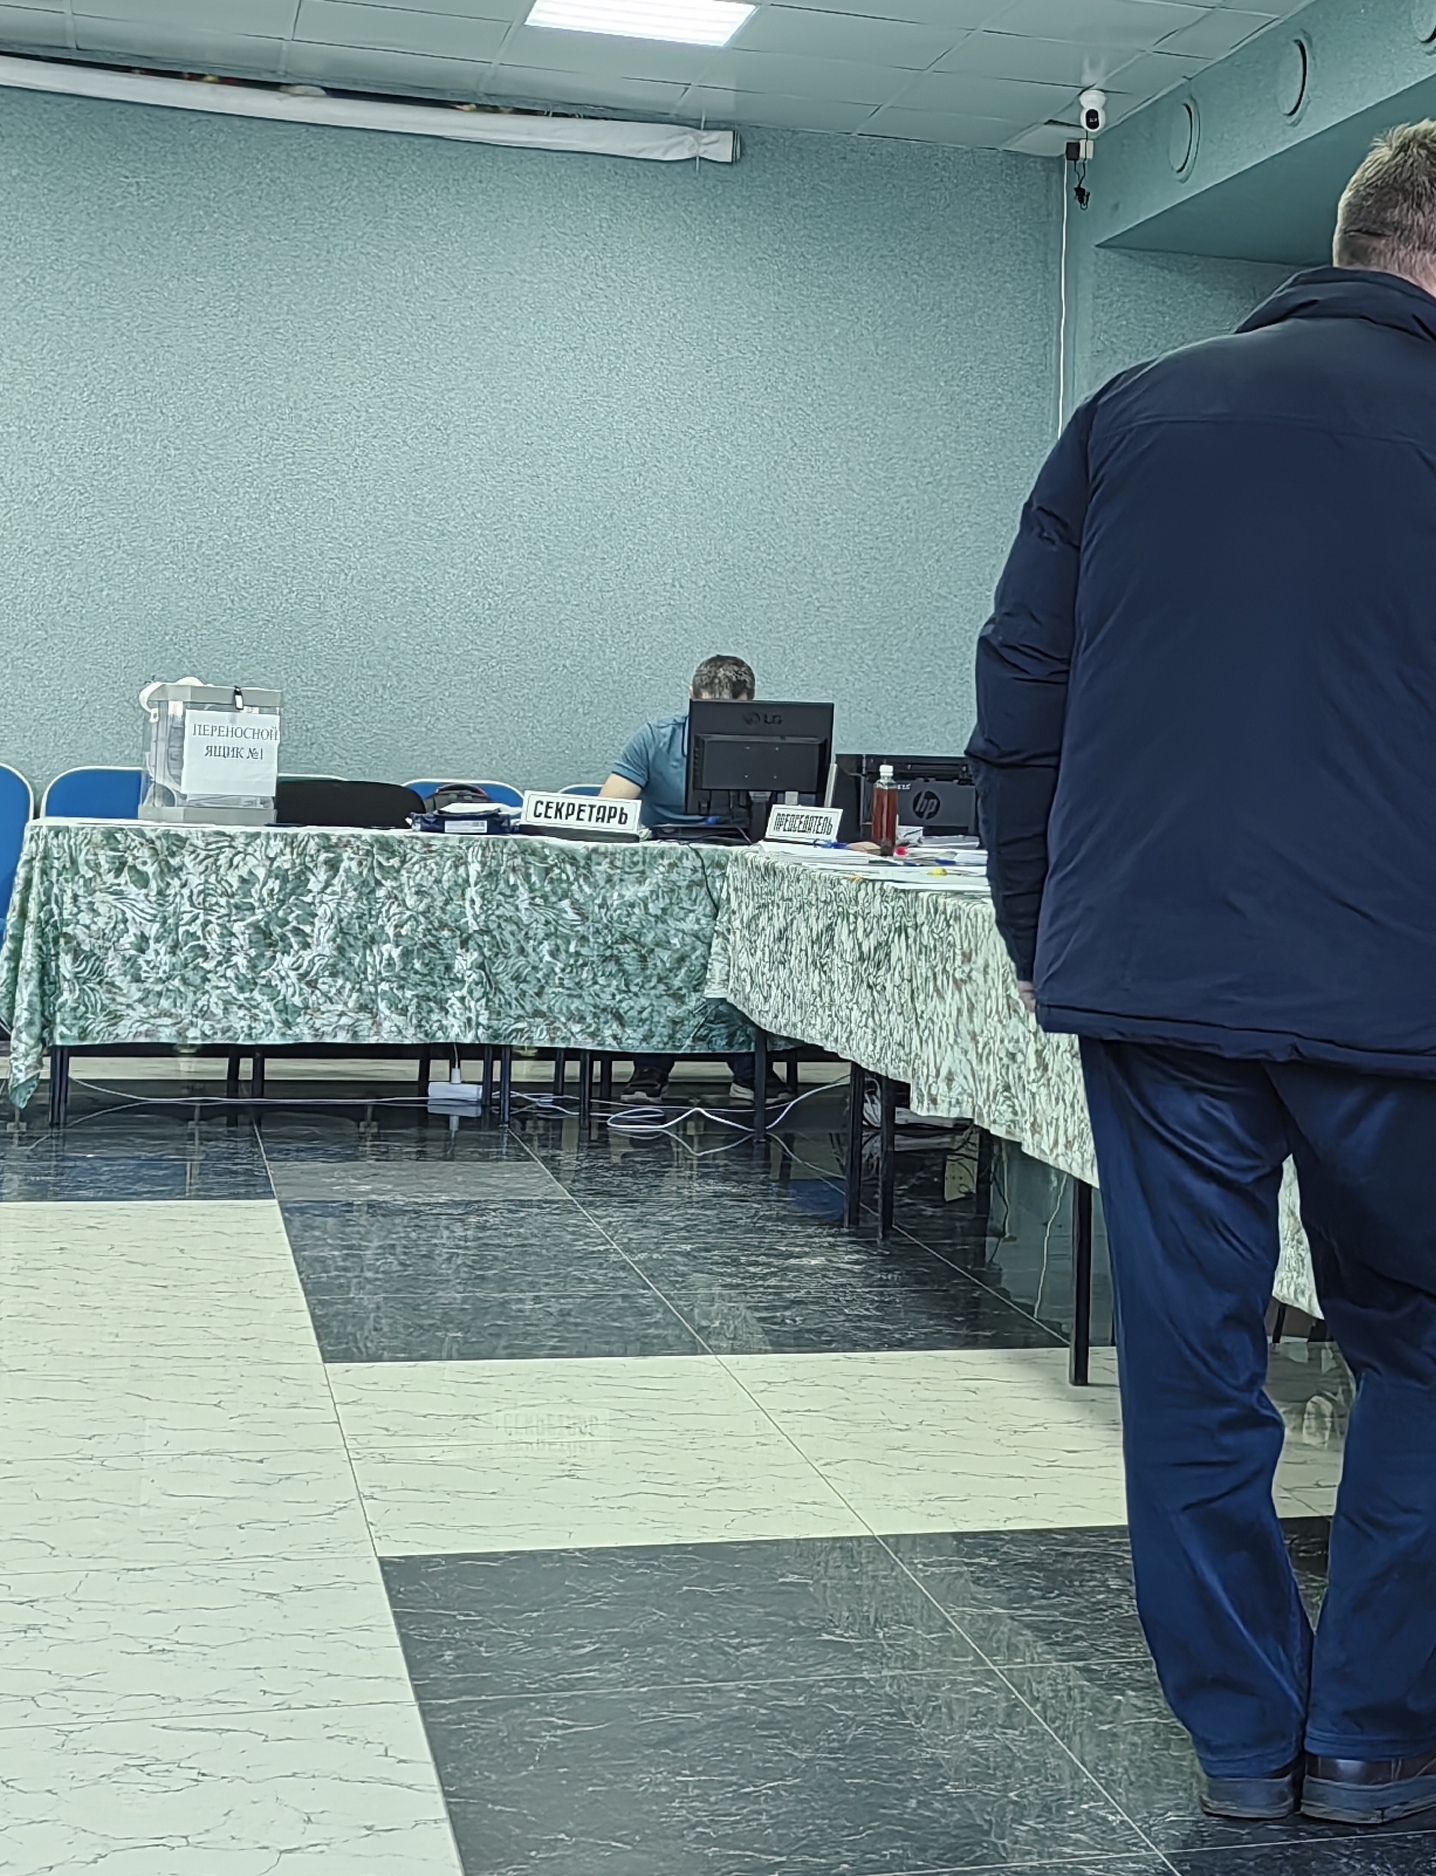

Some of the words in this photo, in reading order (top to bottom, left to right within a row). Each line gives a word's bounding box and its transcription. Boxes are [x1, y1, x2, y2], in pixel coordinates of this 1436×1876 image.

[764, 713, 782, 725] LG
[192, 723, 278, 741] ПЕРЕНОСНОЙ
[204, 744, 245, 759] ЯЩИК
[533, 799, 628, 825] СЕКРЕТАРЬ
[914, 790, 939, 820] hp
[773, 812, 834, 836] ПРЕДСЕДАТЕЛЬ
